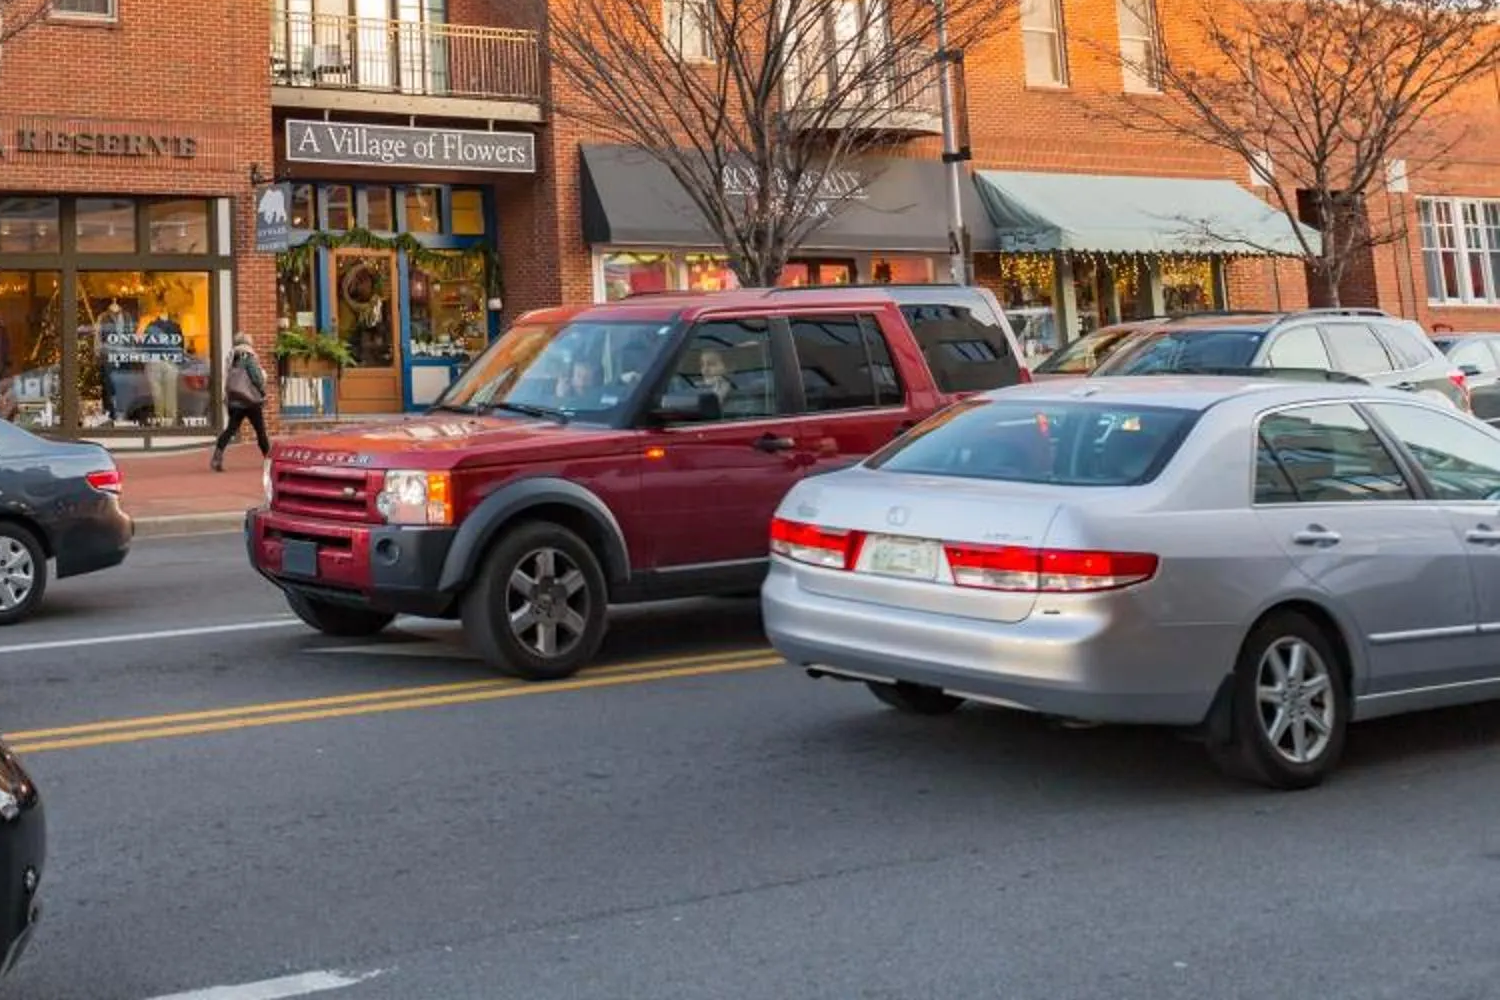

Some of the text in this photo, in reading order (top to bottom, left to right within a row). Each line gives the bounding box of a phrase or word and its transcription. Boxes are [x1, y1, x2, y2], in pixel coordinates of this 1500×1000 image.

[300, 126, 526, 163] A Village of Flowers
[107, 333, 182, 345] ONWARD
